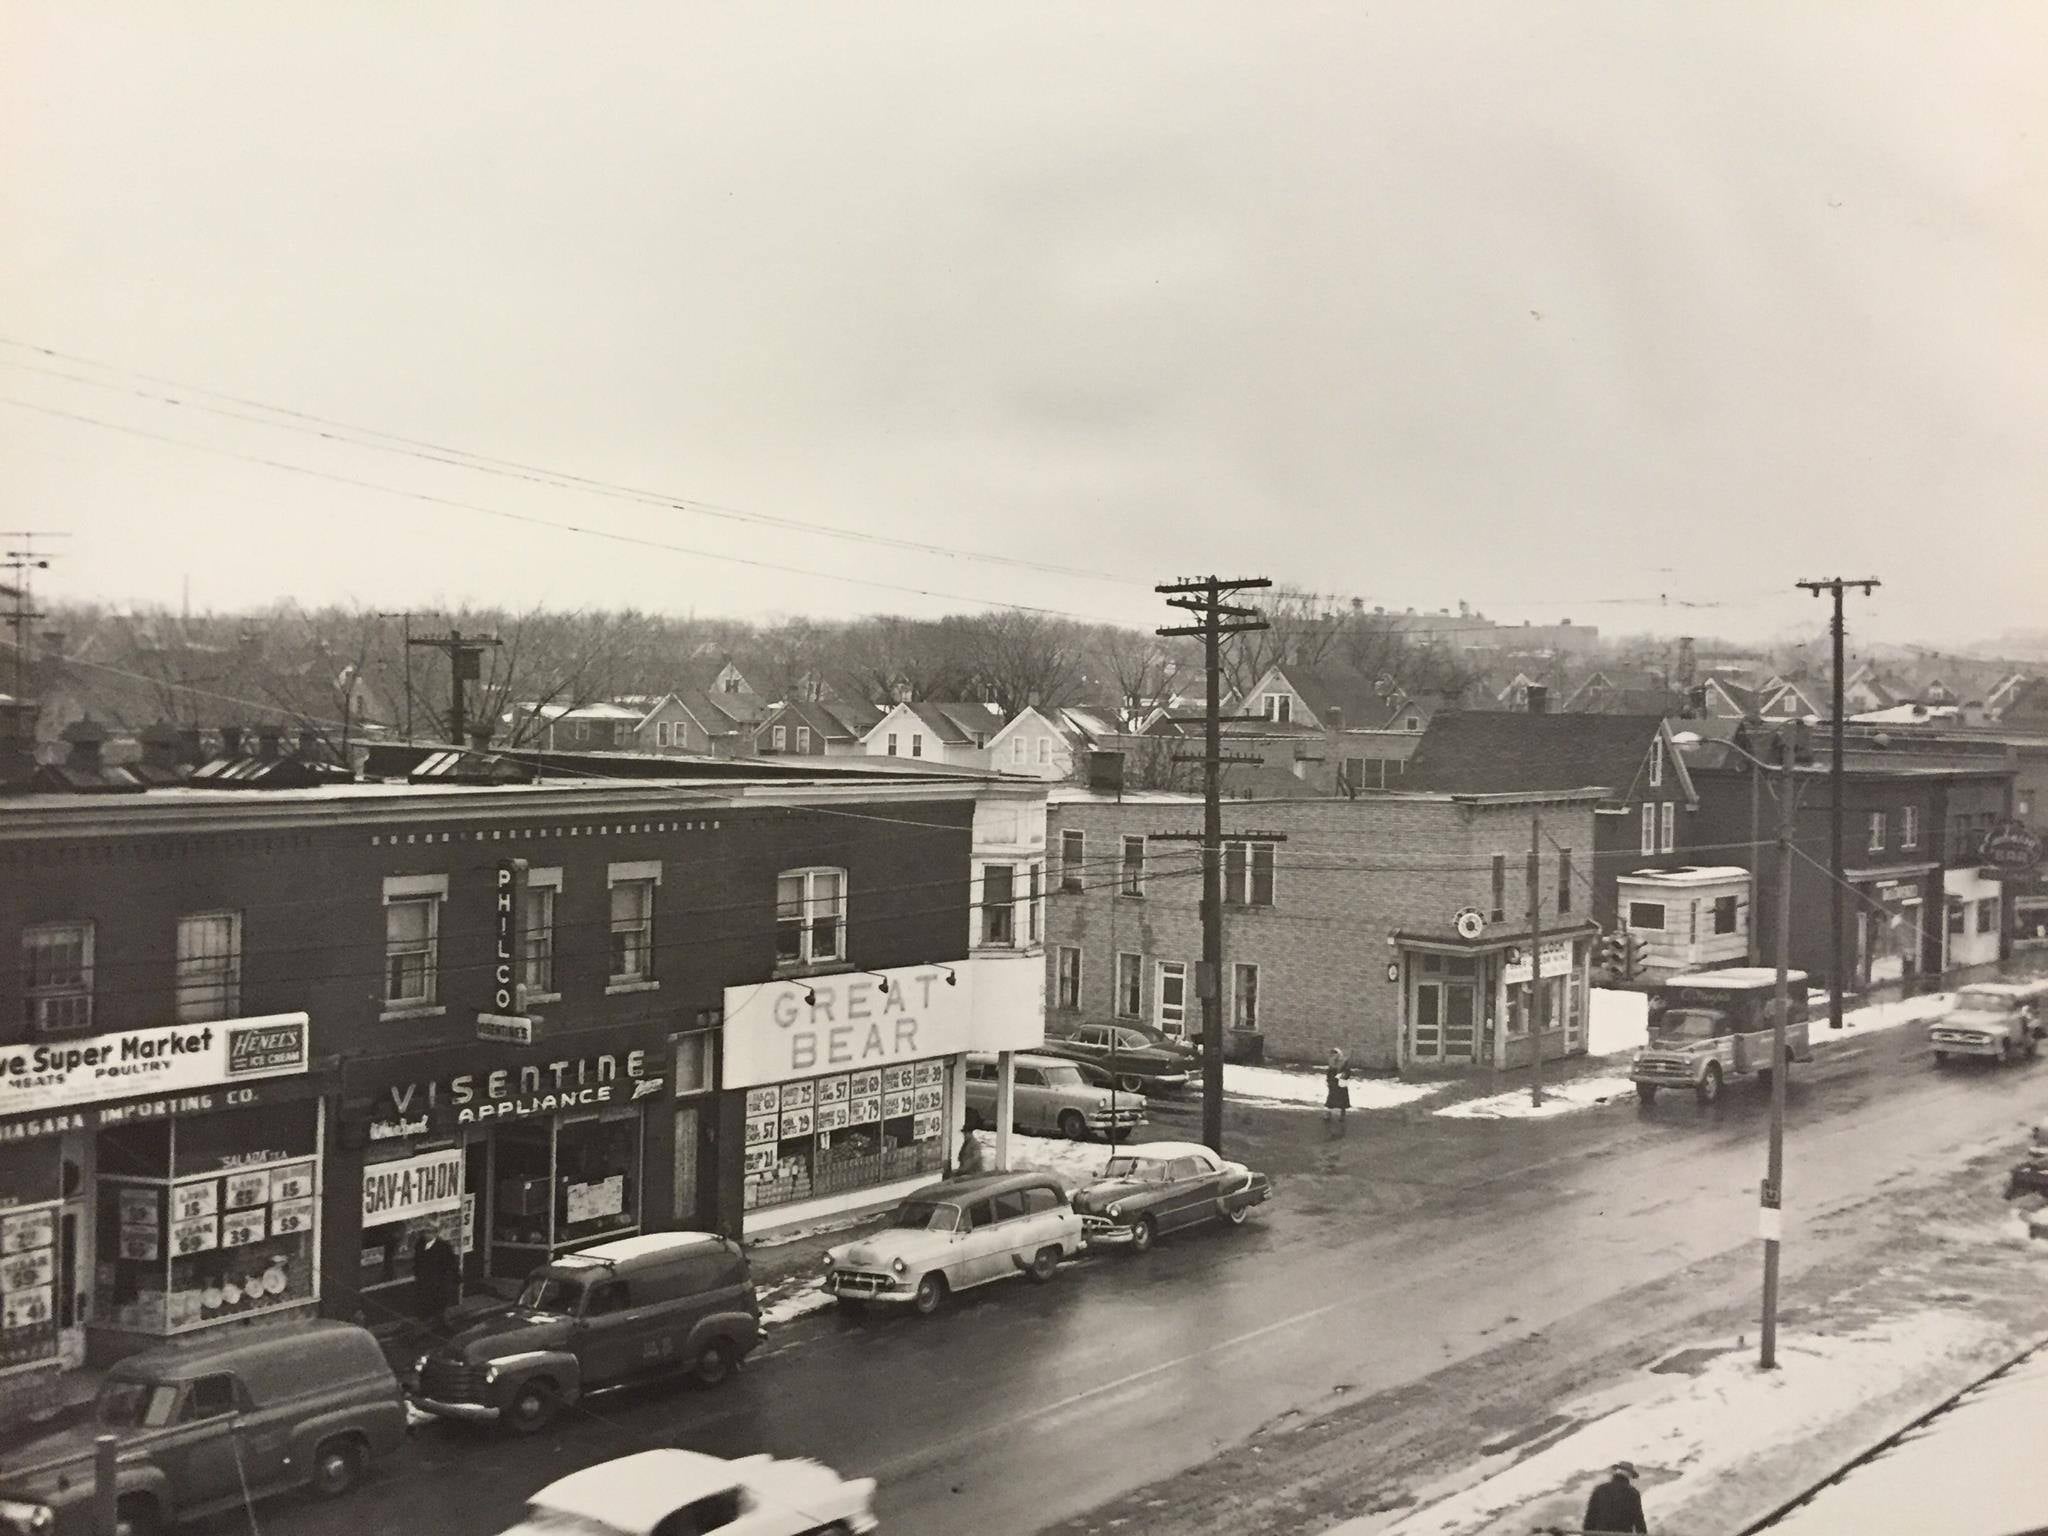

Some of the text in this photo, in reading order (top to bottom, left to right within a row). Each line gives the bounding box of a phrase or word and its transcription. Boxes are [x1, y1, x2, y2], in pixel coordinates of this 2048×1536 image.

[496, 869, 511, 1008] PHILCO
[773, 973, 938, 1029] GREAT
[33, 1045, 114, 1074] Super
[121, 1026, 214, 1062] Market
[249, 1051, 300, 1067] ICE CREAM
[792, 1017, 918, 1070] BEAR
[8, 1060, 172, 1089] MEATS POULTRY
[391, 1050, 645, 1113] VISENTINE
[836, 1081, 848, 1100] 57
[901, 1070, 912, 1087] 65
[0, 1114, 84, 1140] IAGARA
[100, 1094, 213, 1124] IMPORTING
[226, 1088, 259, 1105] CO.
[458, 1086, 614, 1124] APPLIANCE
[868, 1099, 879, 1120] 79
[763, 1121, 775, 1139] 57
[365, 1161, 460, 1215] SAV-A-THON
